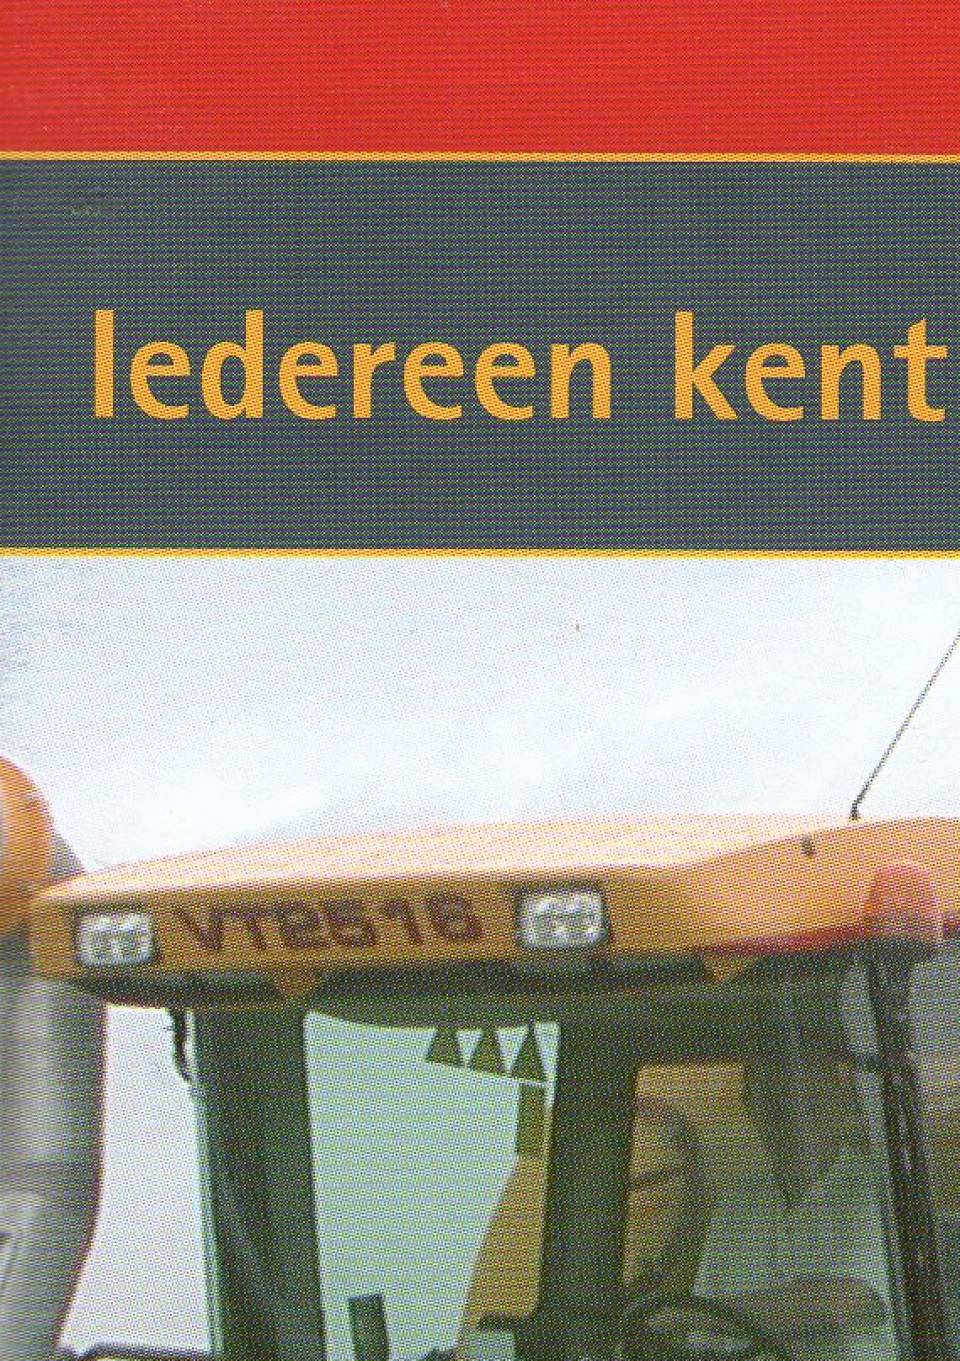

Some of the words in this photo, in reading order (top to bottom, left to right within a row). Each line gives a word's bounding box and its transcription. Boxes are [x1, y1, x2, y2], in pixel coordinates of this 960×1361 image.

[93, 308, 612, 421] Iedereen
[674, 310, 948, 422] kent
[166, 888, 485, 951] VT2516
